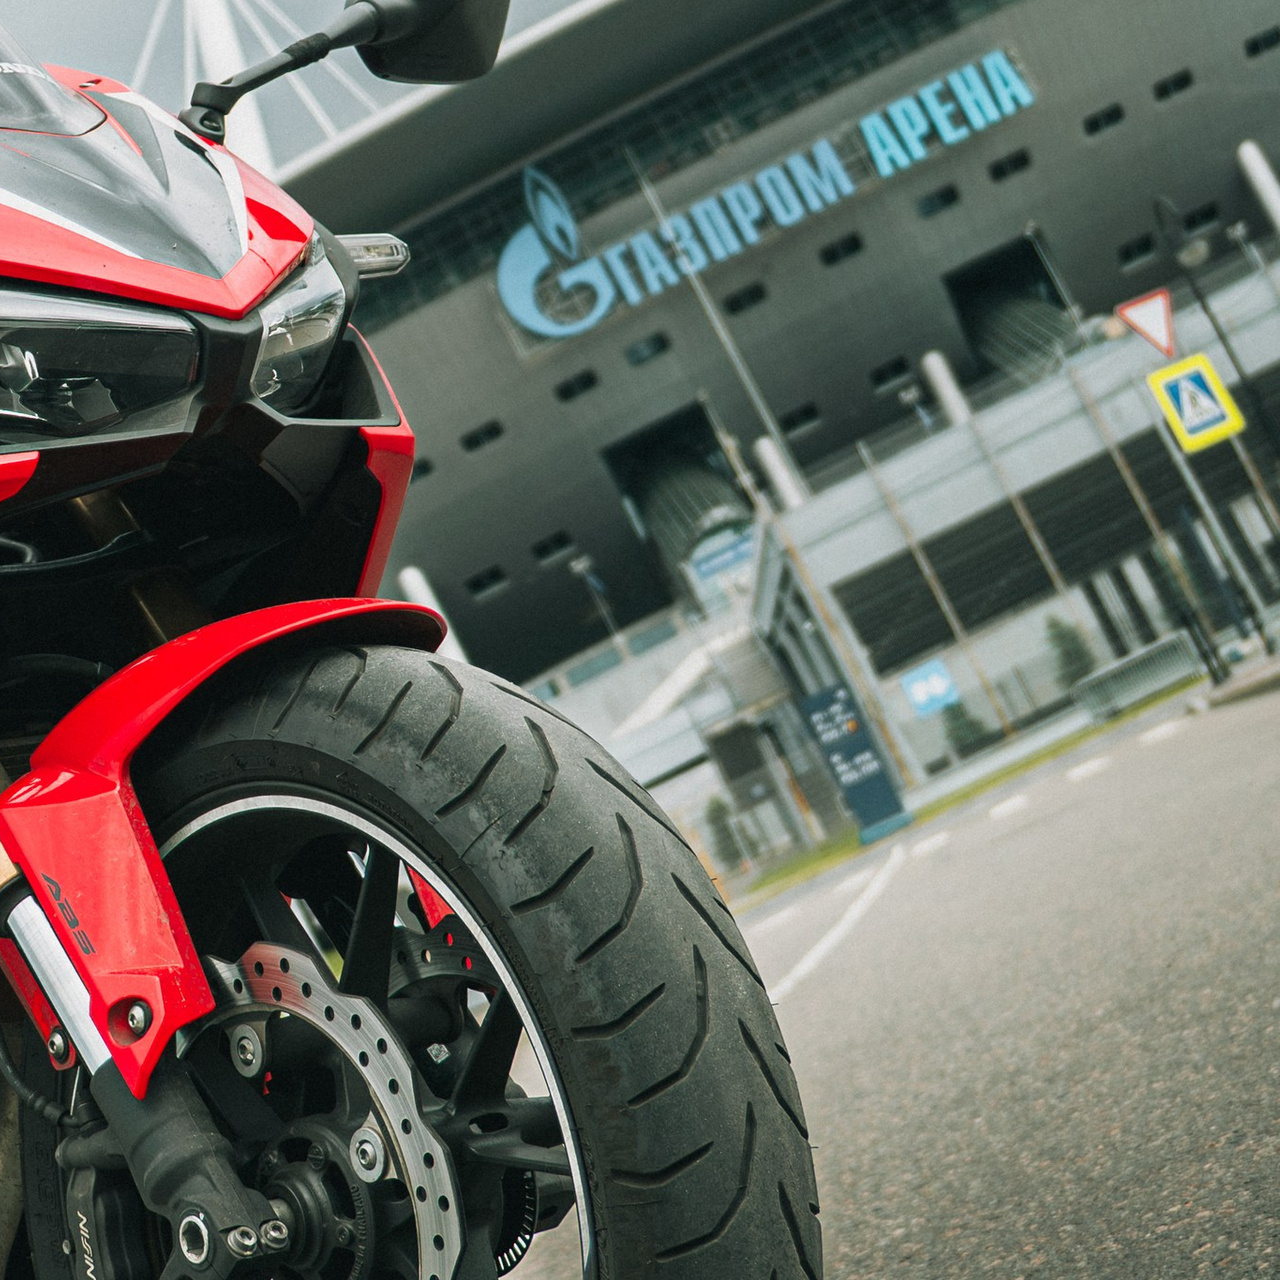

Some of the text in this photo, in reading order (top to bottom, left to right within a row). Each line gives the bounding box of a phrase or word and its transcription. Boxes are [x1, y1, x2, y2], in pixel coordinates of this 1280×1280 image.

[603, 49, 1035, 307] ГАЗПРОМ АРЕНА
[40, 872, 97, 955] ABS
